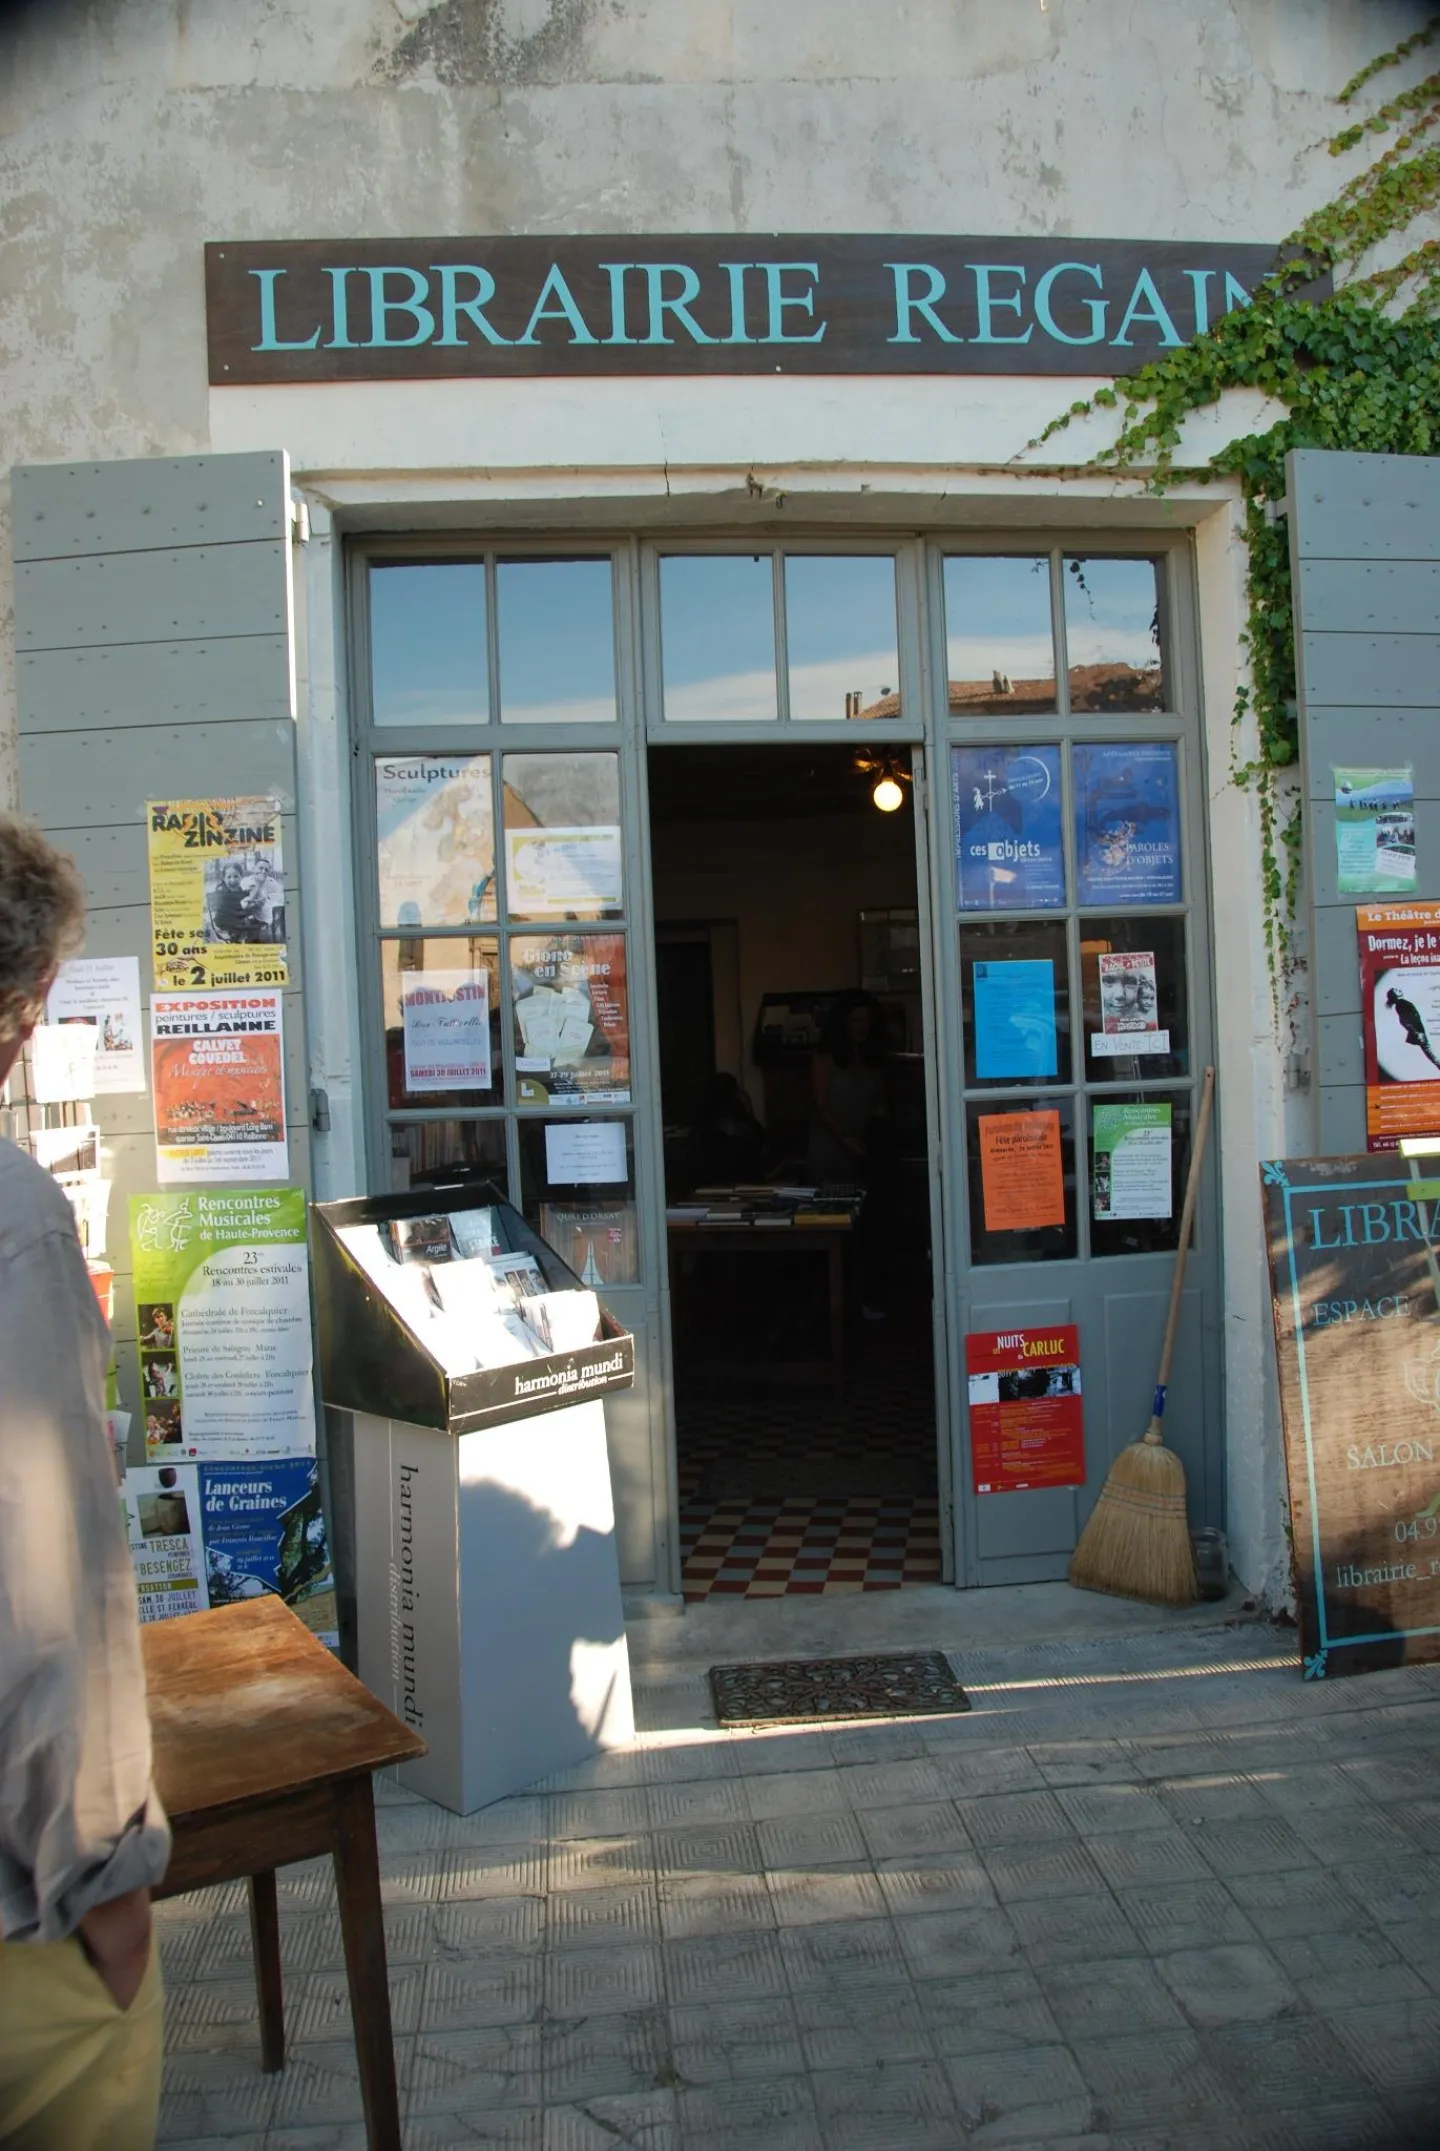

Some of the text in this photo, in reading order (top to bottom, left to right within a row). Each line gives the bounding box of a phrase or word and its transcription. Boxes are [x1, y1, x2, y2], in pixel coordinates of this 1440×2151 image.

[248, 262, 828, 351] LIBRAIRIE
[383, 763, 491, 783] Sculptures
[152, 811, 225, 832] RADIO
[184, 825, 275, 848] ZINZINE
[969, 843, 987, 857] ces
[1125, 842, 1170, 853] PAROLES
[1367, 912, 1383, 922] Le
[1384, 910, 1431, 921] Théâtre
[155, 928, 185, 940] Fête
[155, 942, 208, 957] 30 ans
[1367, 933, 1437, 953] Dormez, je le
[173, 966, 286, 987] le 2 juillet 2011
[534, 961, 611, 978] en Scène
[155, 998, 276, 1013] EXPOSITION
[155, 1012, 207, 1025] peintures
[218, 1009, 276, 1021] sculptures
[157, 1020, 276, 1035] REILLANNE
[192, 1039, 242, 1053] CALVET
[1095, 1039, 1108, 1051] EN
[198, 1194, 281, 1211] Rencontres
[199, 1210, 272, 1227] Musicales
[200, 1226, 300, 1241] de Haute-Provence
[426, 1244, 448, 1255] Argile
[202, 1263, 302, 1276] Rencontres estivales
[211, 1278, 221, 1288] 18
[246, 1277, 269, 1288] juillet
[270, 1275, 289, 1285] 2011
[1313, 1296, 1412, 1326] ESPACE
[997, 1334, 1025, 1349] NUITS
[1023, 1338, 1065, 1357] CARLUC
[515, 1352, 623, 1395] harmonia mundi
[558, 1375, 608, 1396] distribution
[1347, 1439, 1434, 1470] SALON
[205, 1478, 273, 1496] Lanceurs
[205, 1493, 287, 1512] de Graines
[150, 1538, 189, 1553] TRESCA
[139, 1558, 192, 1576] BESENGEZ
[400, 1464, 424, 1728] harmonia mundi
[388, 1561, 402, 1680] distribution
